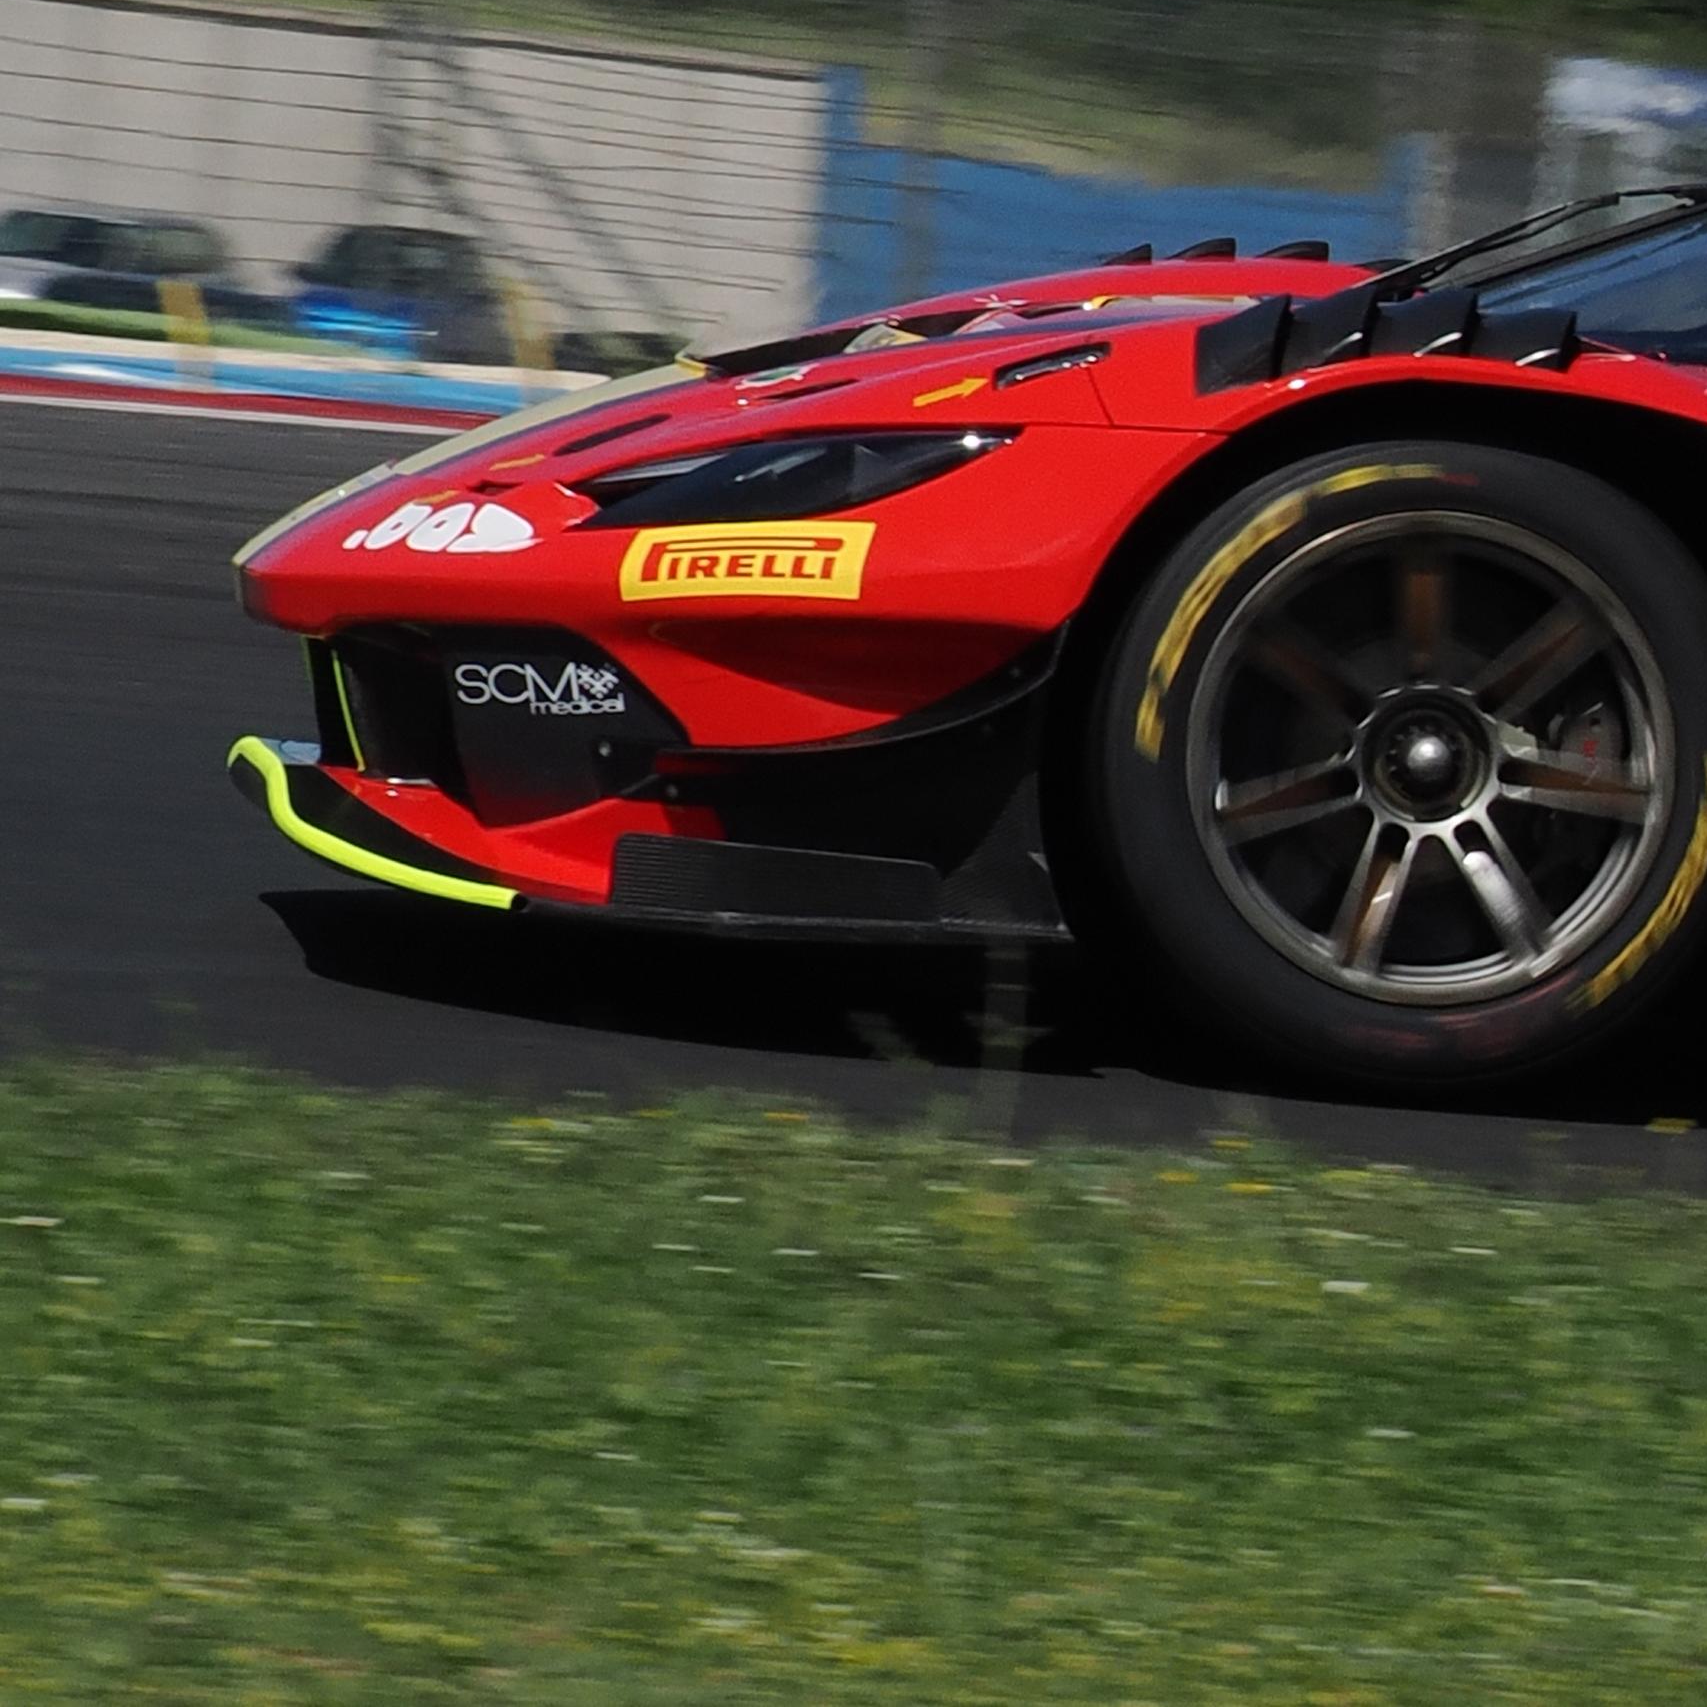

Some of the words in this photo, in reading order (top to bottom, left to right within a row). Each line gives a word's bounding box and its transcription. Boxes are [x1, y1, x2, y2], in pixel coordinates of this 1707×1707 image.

[640, 536, 844, 582] PIRELLI
[455, 662, 580, 704] SCM
[530, 692, 625, 715] medical
